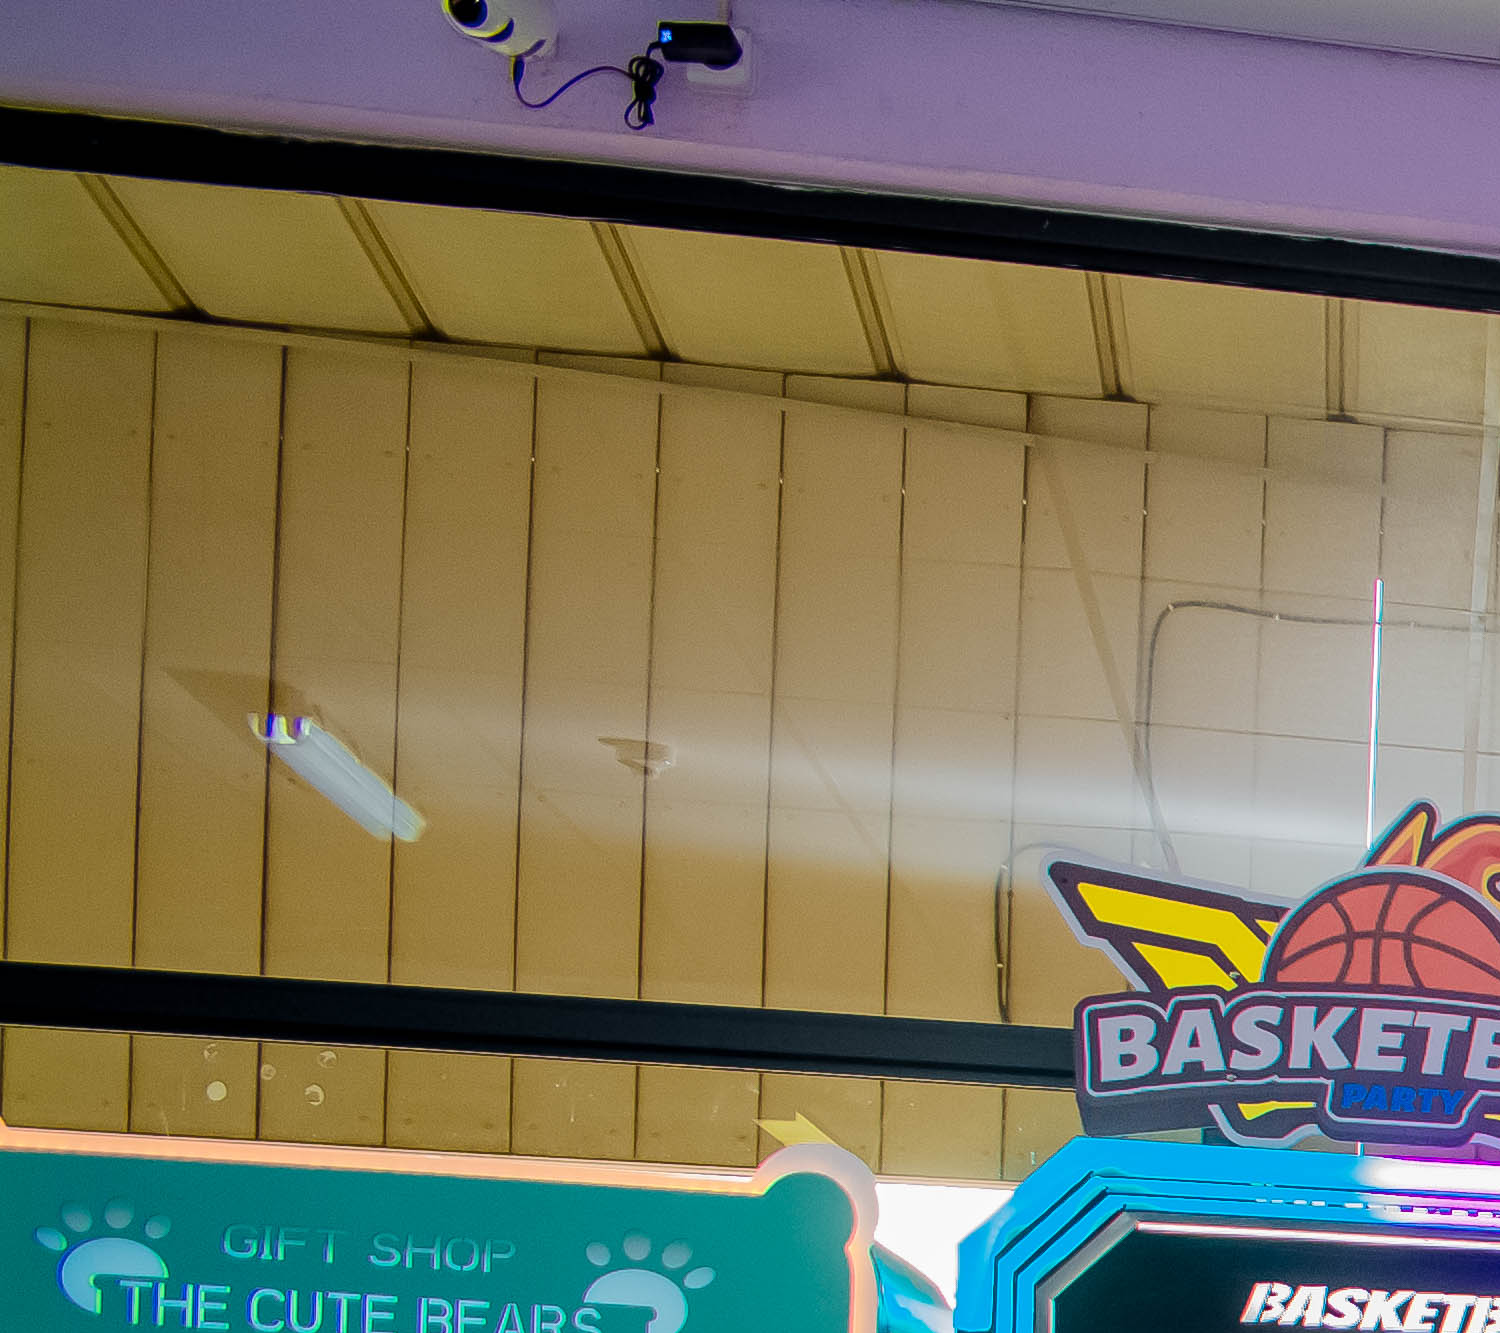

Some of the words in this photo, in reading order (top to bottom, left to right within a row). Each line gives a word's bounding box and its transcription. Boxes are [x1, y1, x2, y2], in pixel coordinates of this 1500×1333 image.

[1340, 1082, 1467, 1116] PARTY
[222, 1223, 337, 1266] GIFT
[367, 1232, 517, 1273] SHOP
[121, 1277, 231, 1332] THE
